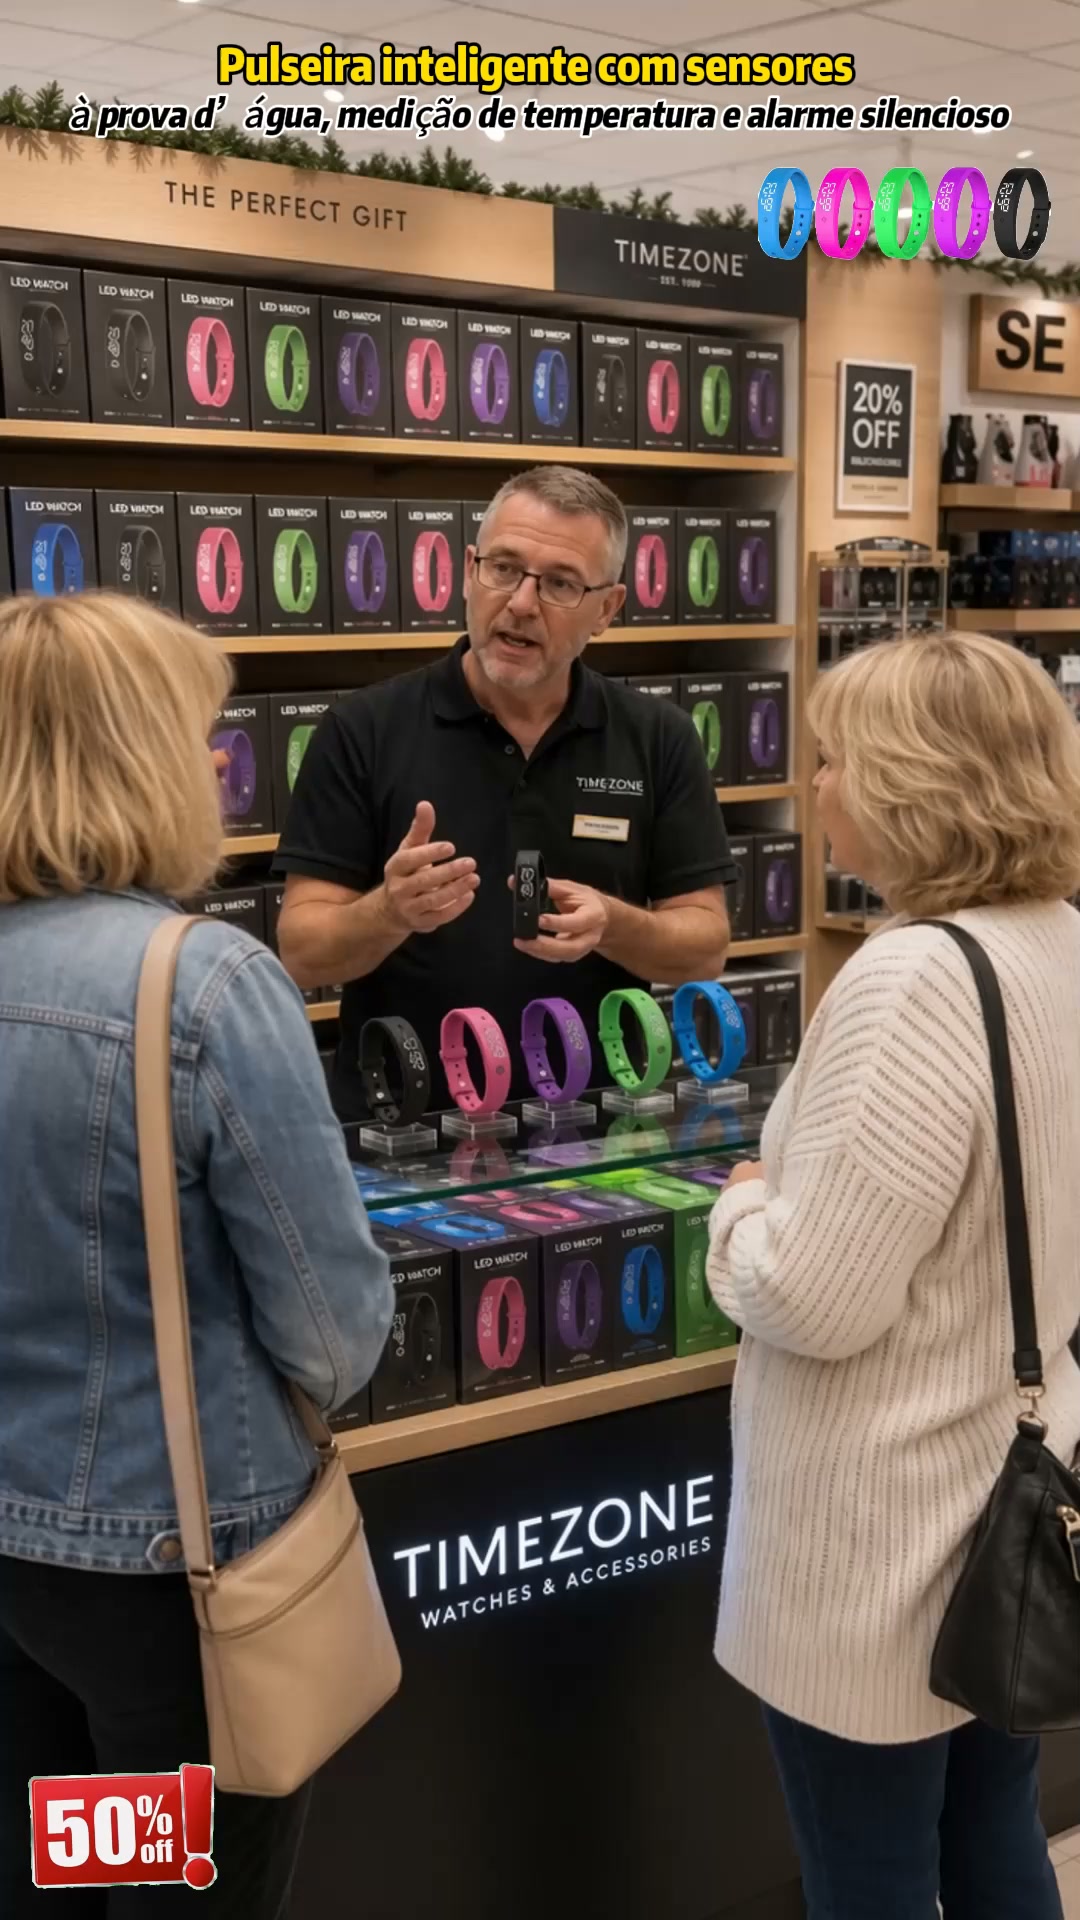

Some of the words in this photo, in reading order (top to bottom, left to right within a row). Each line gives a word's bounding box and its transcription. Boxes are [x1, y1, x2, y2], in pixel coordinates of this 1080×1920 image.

[164, 181, 216, 208] THE
[230, 189, 340, 223] PERFECT
[352, 205, 407, 232] GIFT
[614, 239, 745, 277] TIMEZONE
[995, 309, 1066, 373] SE
[852, 381, 903, 415] 20%
[852, 418, 901, 449] OFF
[576, 776, 644, 792] TIMEZONE
[393, 1475, 714, 1598] TIMEZONE
[420, 1584, 532, 1629] WATCHES
[542, 1578, 556, 1595] &
[566, 1536, 712, 1590] ACCESSORIES
